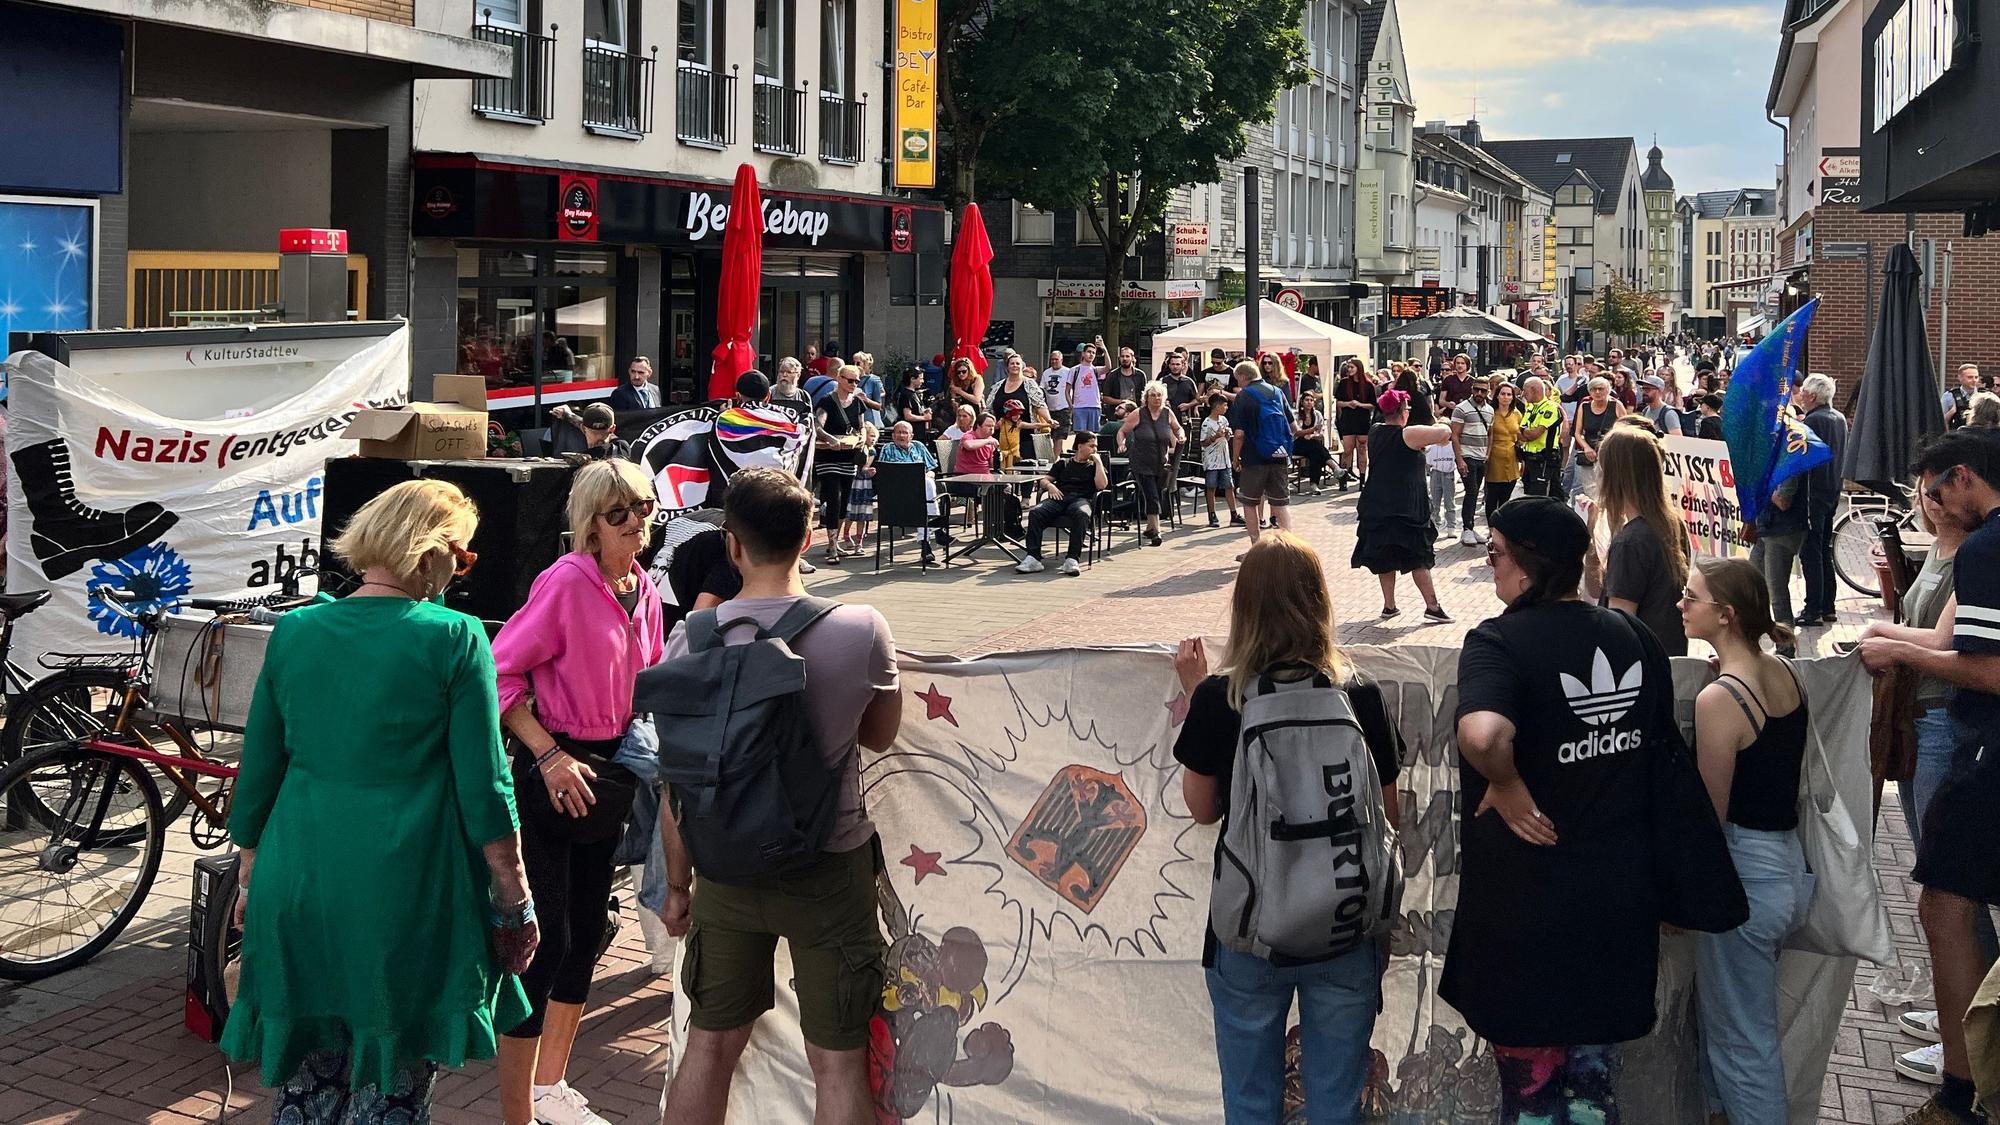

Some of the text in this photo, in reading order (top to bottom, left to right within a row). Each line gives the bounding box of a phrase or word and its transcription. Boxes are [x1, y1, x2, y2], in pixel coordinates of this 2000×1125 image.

[900, 26, 933, 41] Bistro
[897, 50, 936, 74] BEY
[902, 78, 930, 92] Café-
[906, 95, 925, 109] Bar
[1377, 62, 1391, 131] HOTEL
[686, 191, 730, 241] Be
[1175, 227, 1200, 235] Schuh-
[1175, 237, 1208, 246] Schlüssel
[1175, 248, 1198, 256] Dienst
[1047, 288, 1077, 297] Shuh-
[1079, 288, 1086, 297] &
[204, 345, 299, 361] KulturStadtLev
[94, 426, 210, 464] Nazis
[1684, 455, 1717, 485] IST
[247, 476, 325, 531] Auf
[1681, 491, 1709, 514] eine
[1684, 519, 1710, 538] nte
[1558, 727, 1642, 765] adidas
